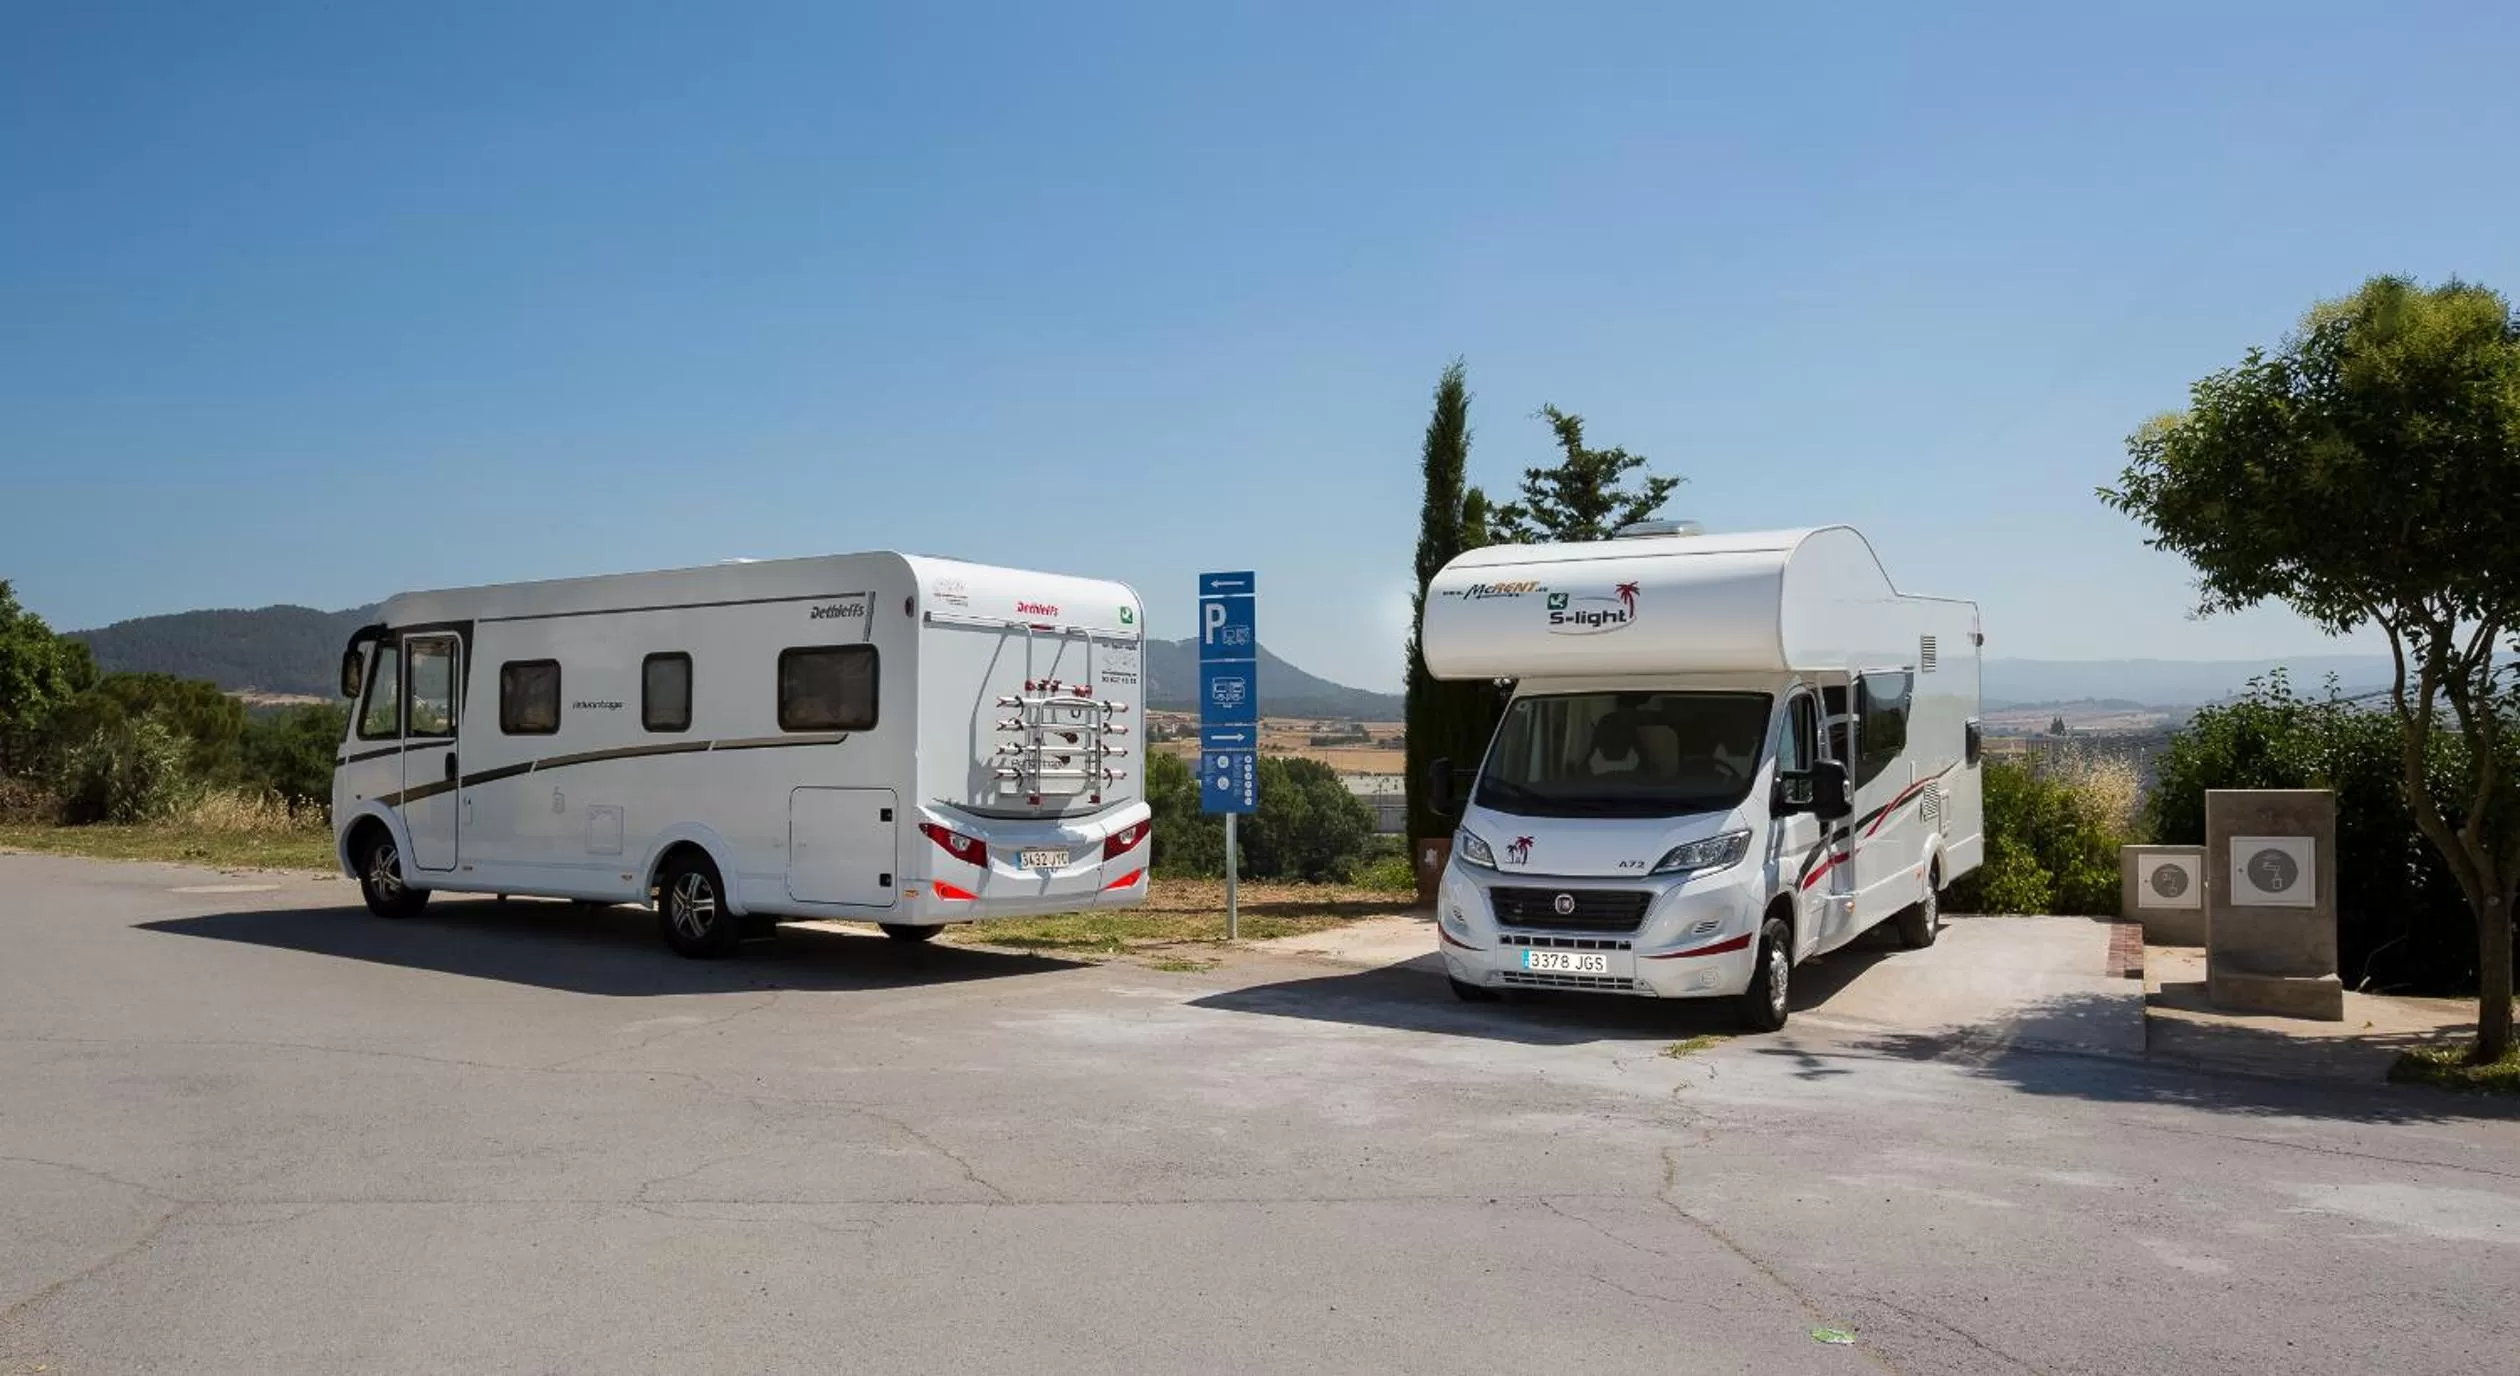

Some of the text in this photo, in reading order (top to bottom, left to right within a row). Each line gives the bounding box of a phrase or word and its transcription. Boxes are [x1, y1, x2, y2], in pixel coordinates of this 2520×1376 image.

[1206, 603, 1227, 645] P
[1550, 609, 1627, 627] S-light
[1531, 953, 1604, 971] 3378 JGS
